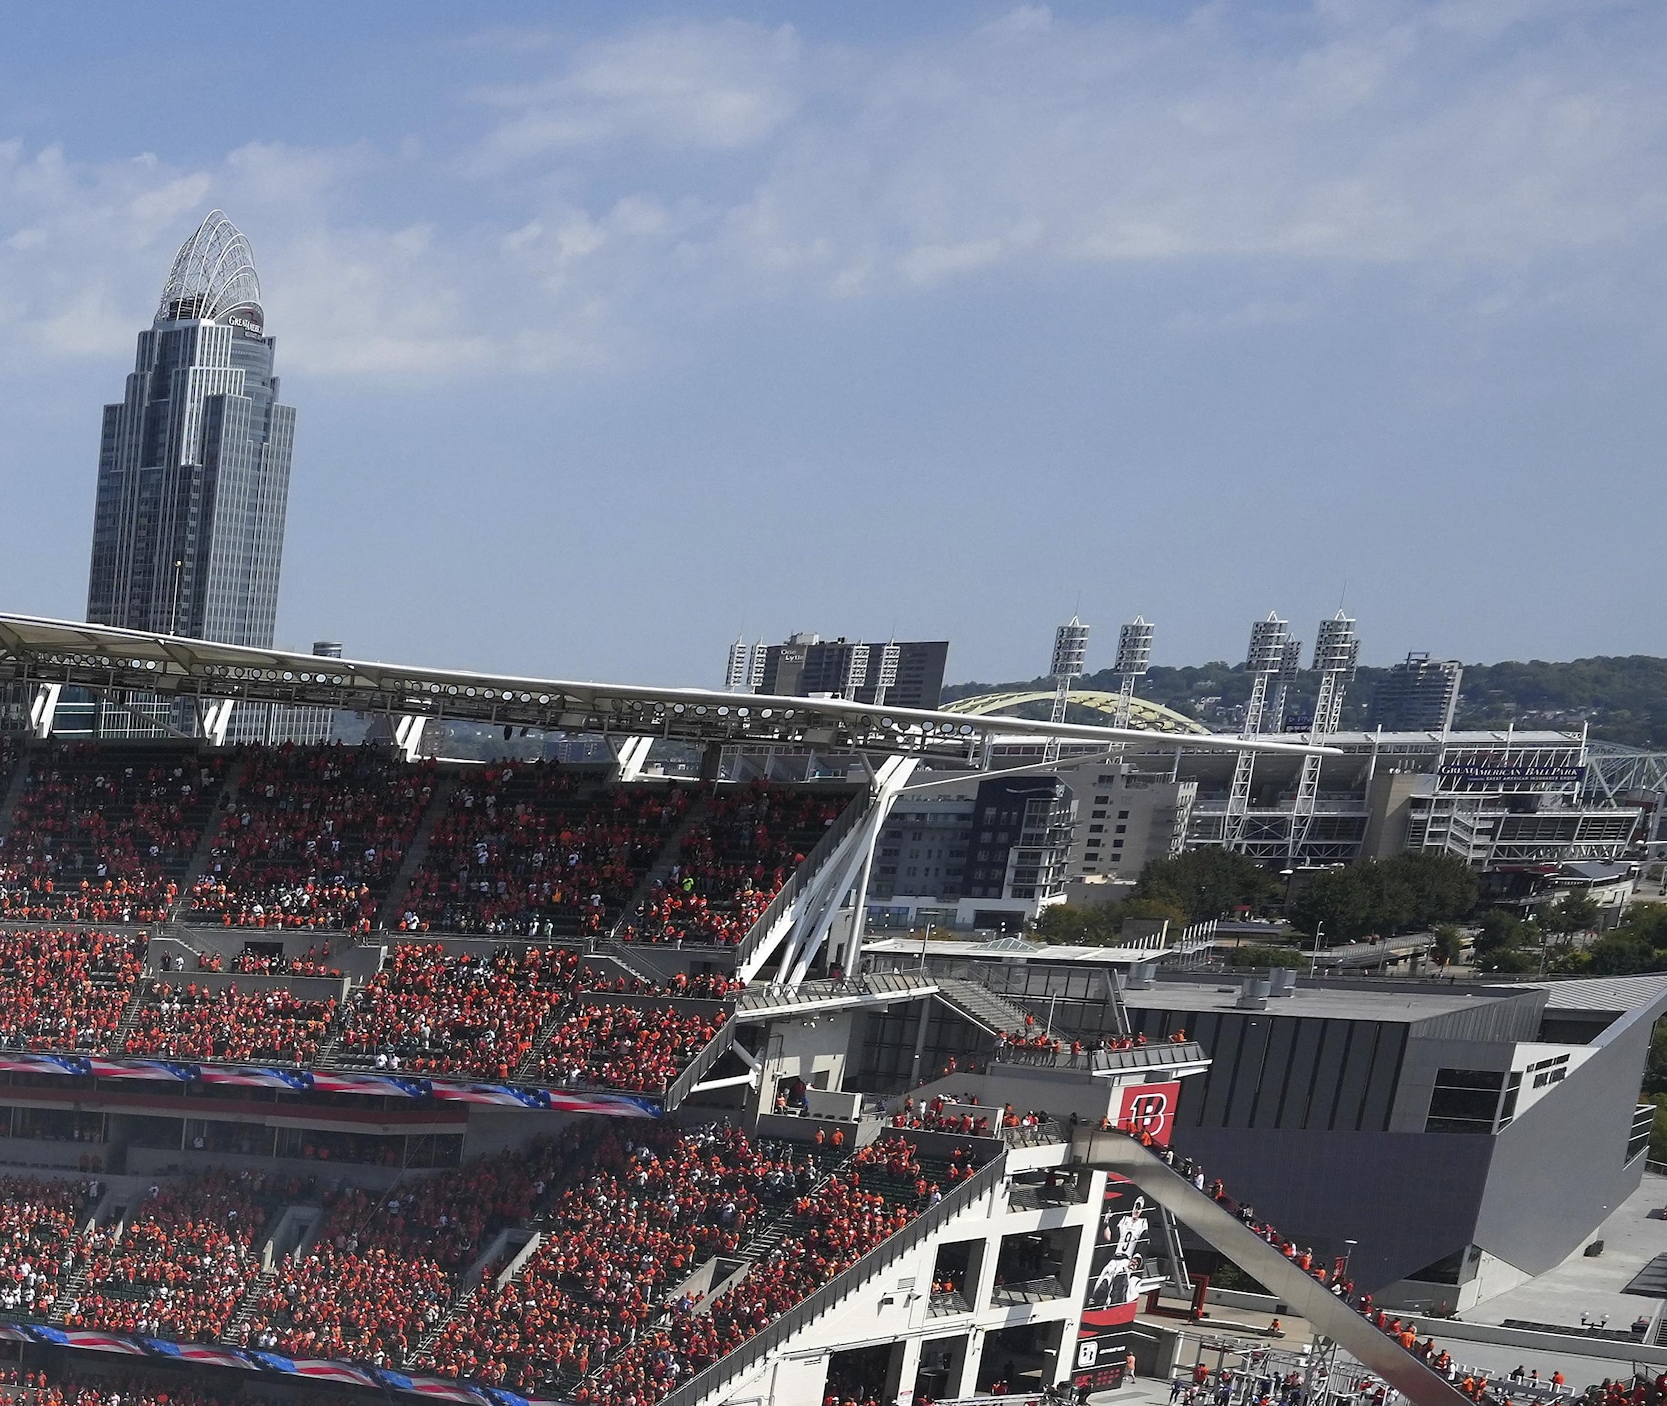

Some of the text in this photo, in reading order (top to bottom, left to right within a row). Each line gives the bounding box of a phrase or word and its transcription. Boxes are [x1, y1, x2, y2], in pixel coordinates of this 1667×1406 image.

[1441, 766, 1578, 776] GREAT AMERICAN BALL PARK
